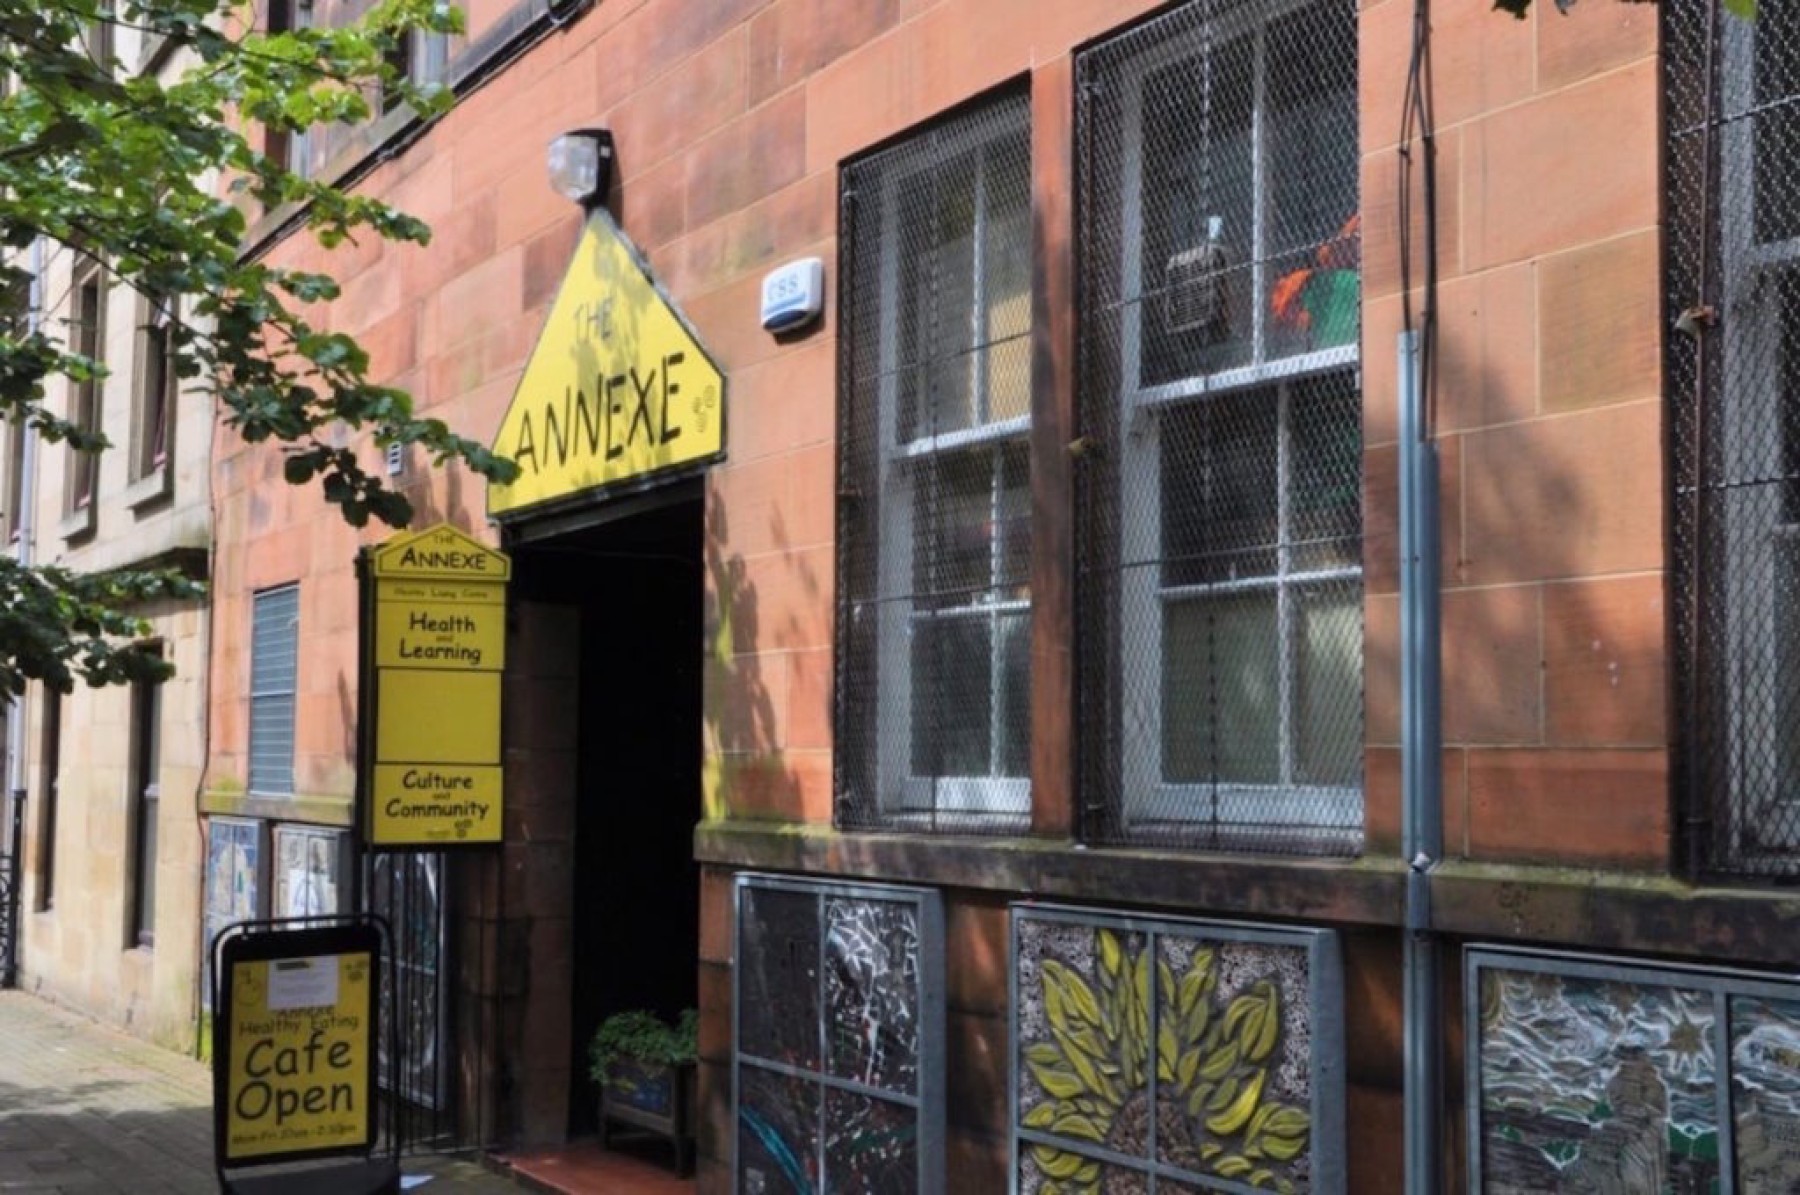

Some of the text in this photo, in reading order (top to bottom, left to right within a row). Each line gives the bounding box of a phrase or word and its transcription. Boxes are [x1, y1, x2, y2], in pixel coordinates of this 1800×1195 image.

[574, 297, 614, 341] THE
[514, 352, 685, 475] ANNEXE
[433, 533, 454, 544] THE
[400, 547, 486, 570] ANNEXE
[409, 611, 476, 632] Health
[399, 637, 482, 665] Learning
[402, 769, 474, 790] Culture
[385, 797, 490, 820] Community
[239, 1014, 359, 1037] Healthy Eating
[244, 1030, 352, 1078] Cafe
[234, 1080, 353, 1126] Open
